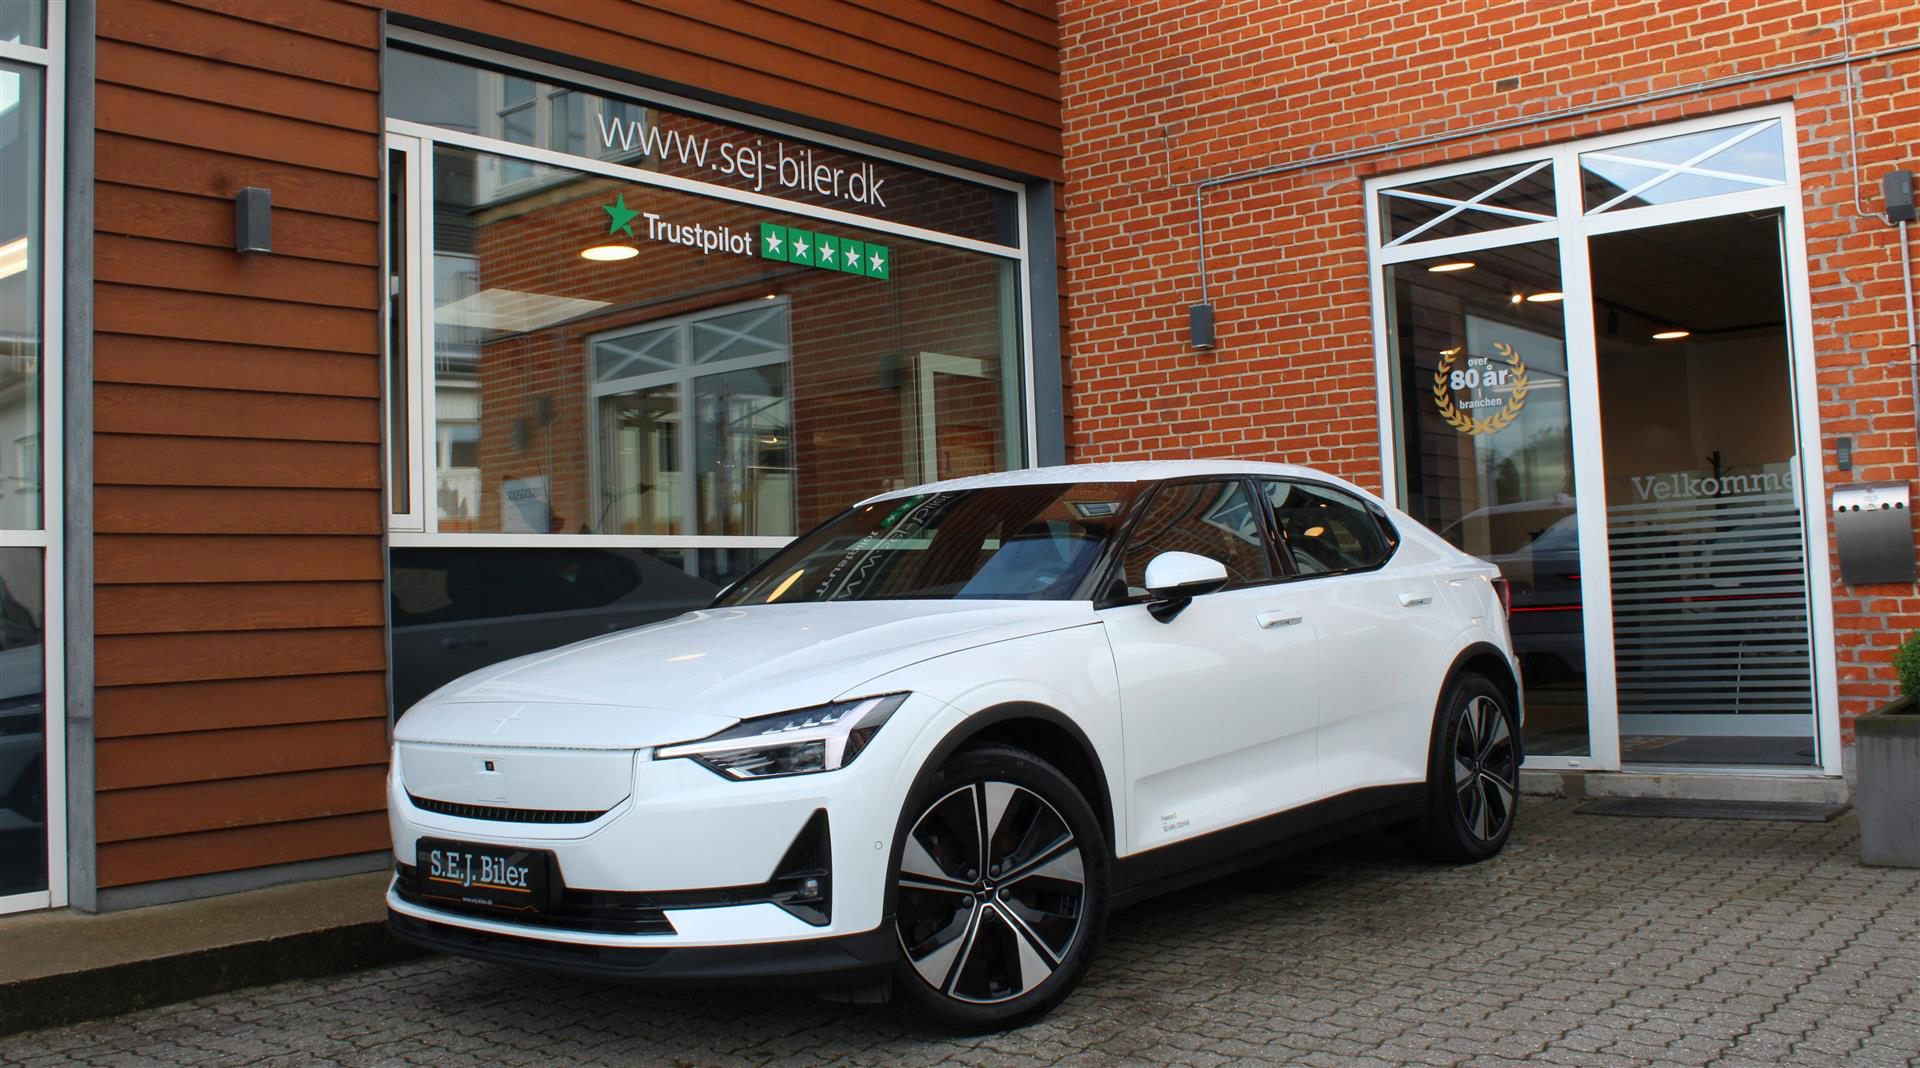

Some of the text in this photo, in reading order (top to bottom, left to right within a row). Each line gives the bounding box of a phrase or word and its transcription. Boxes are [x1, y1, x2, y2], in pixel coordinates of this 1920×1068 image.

[598, 113, 886, 207] www.sej-biler.dk
[643, 212, 752, 255] Trustpilot
[1450, 364, 1509, 390] 80 år
[1468, 357, 1488, 367] over
[1459, 398, 1502, 409] branchen
[431, 850, 528, 887] S.E.J. Biler
